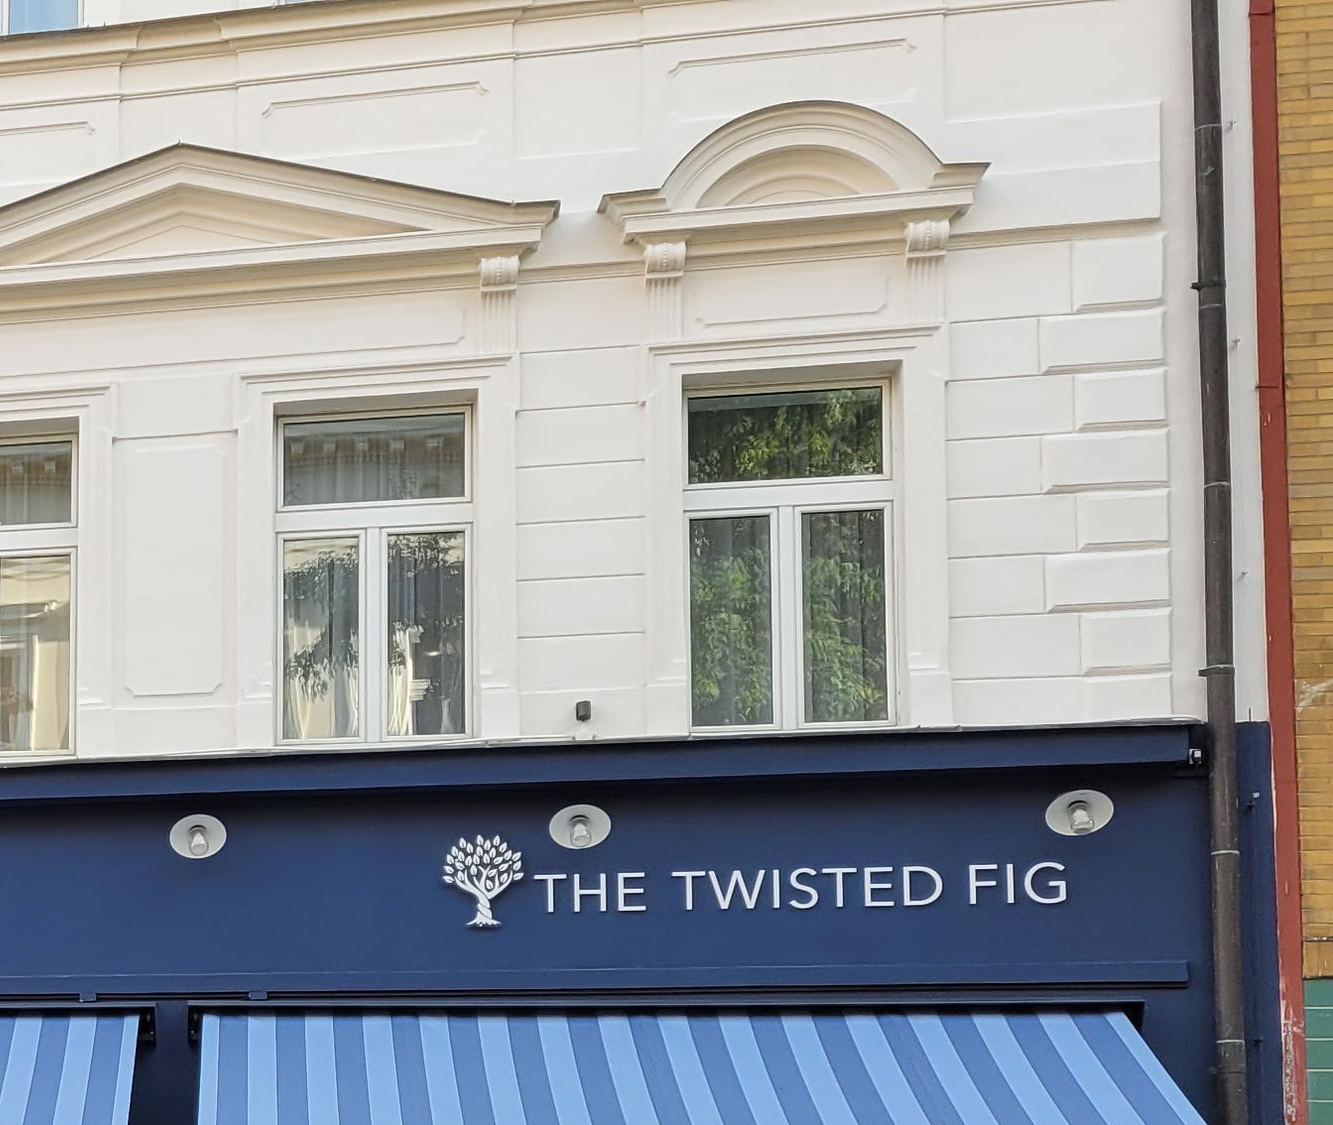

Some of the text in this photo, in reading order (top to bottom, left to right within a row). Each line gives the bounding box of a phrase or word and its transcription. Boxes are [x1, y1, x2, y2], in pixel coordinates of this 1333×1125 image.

[534, 861, 1068, 913] THE TWISTED FIG
